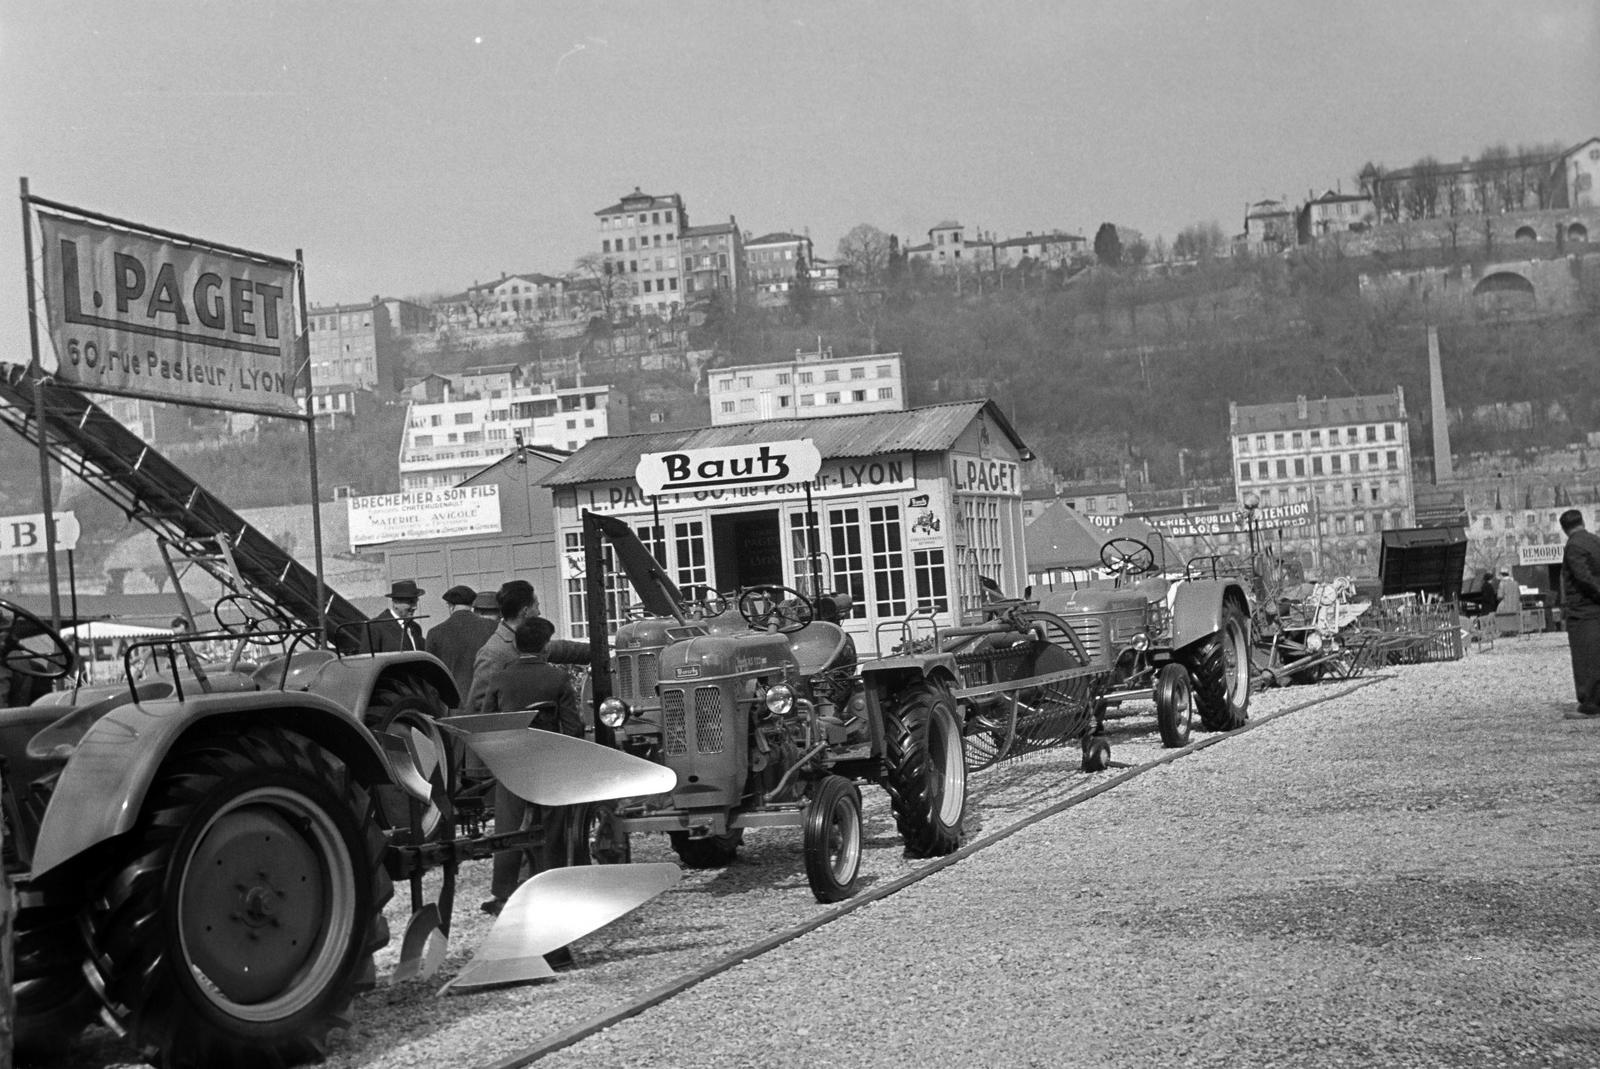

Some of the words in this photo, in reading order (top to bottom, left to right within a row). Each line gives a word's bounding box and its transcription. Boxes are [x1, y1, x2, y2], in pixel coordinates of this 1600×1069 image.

[108, 350, 140, 375] rue
[239, 368, 286, 394] LYON
[661, 446, 790, 490] Bautz
[444, 489, 466, 501] SON
[471, 485, 496, 497] FILS
[1087, 515, 1117, 527] TOUT
[1194, 514, 1218, 525] POUR
[1220, 513, 1231, 523] LA
[1172, 526, 1186, 535] DU
